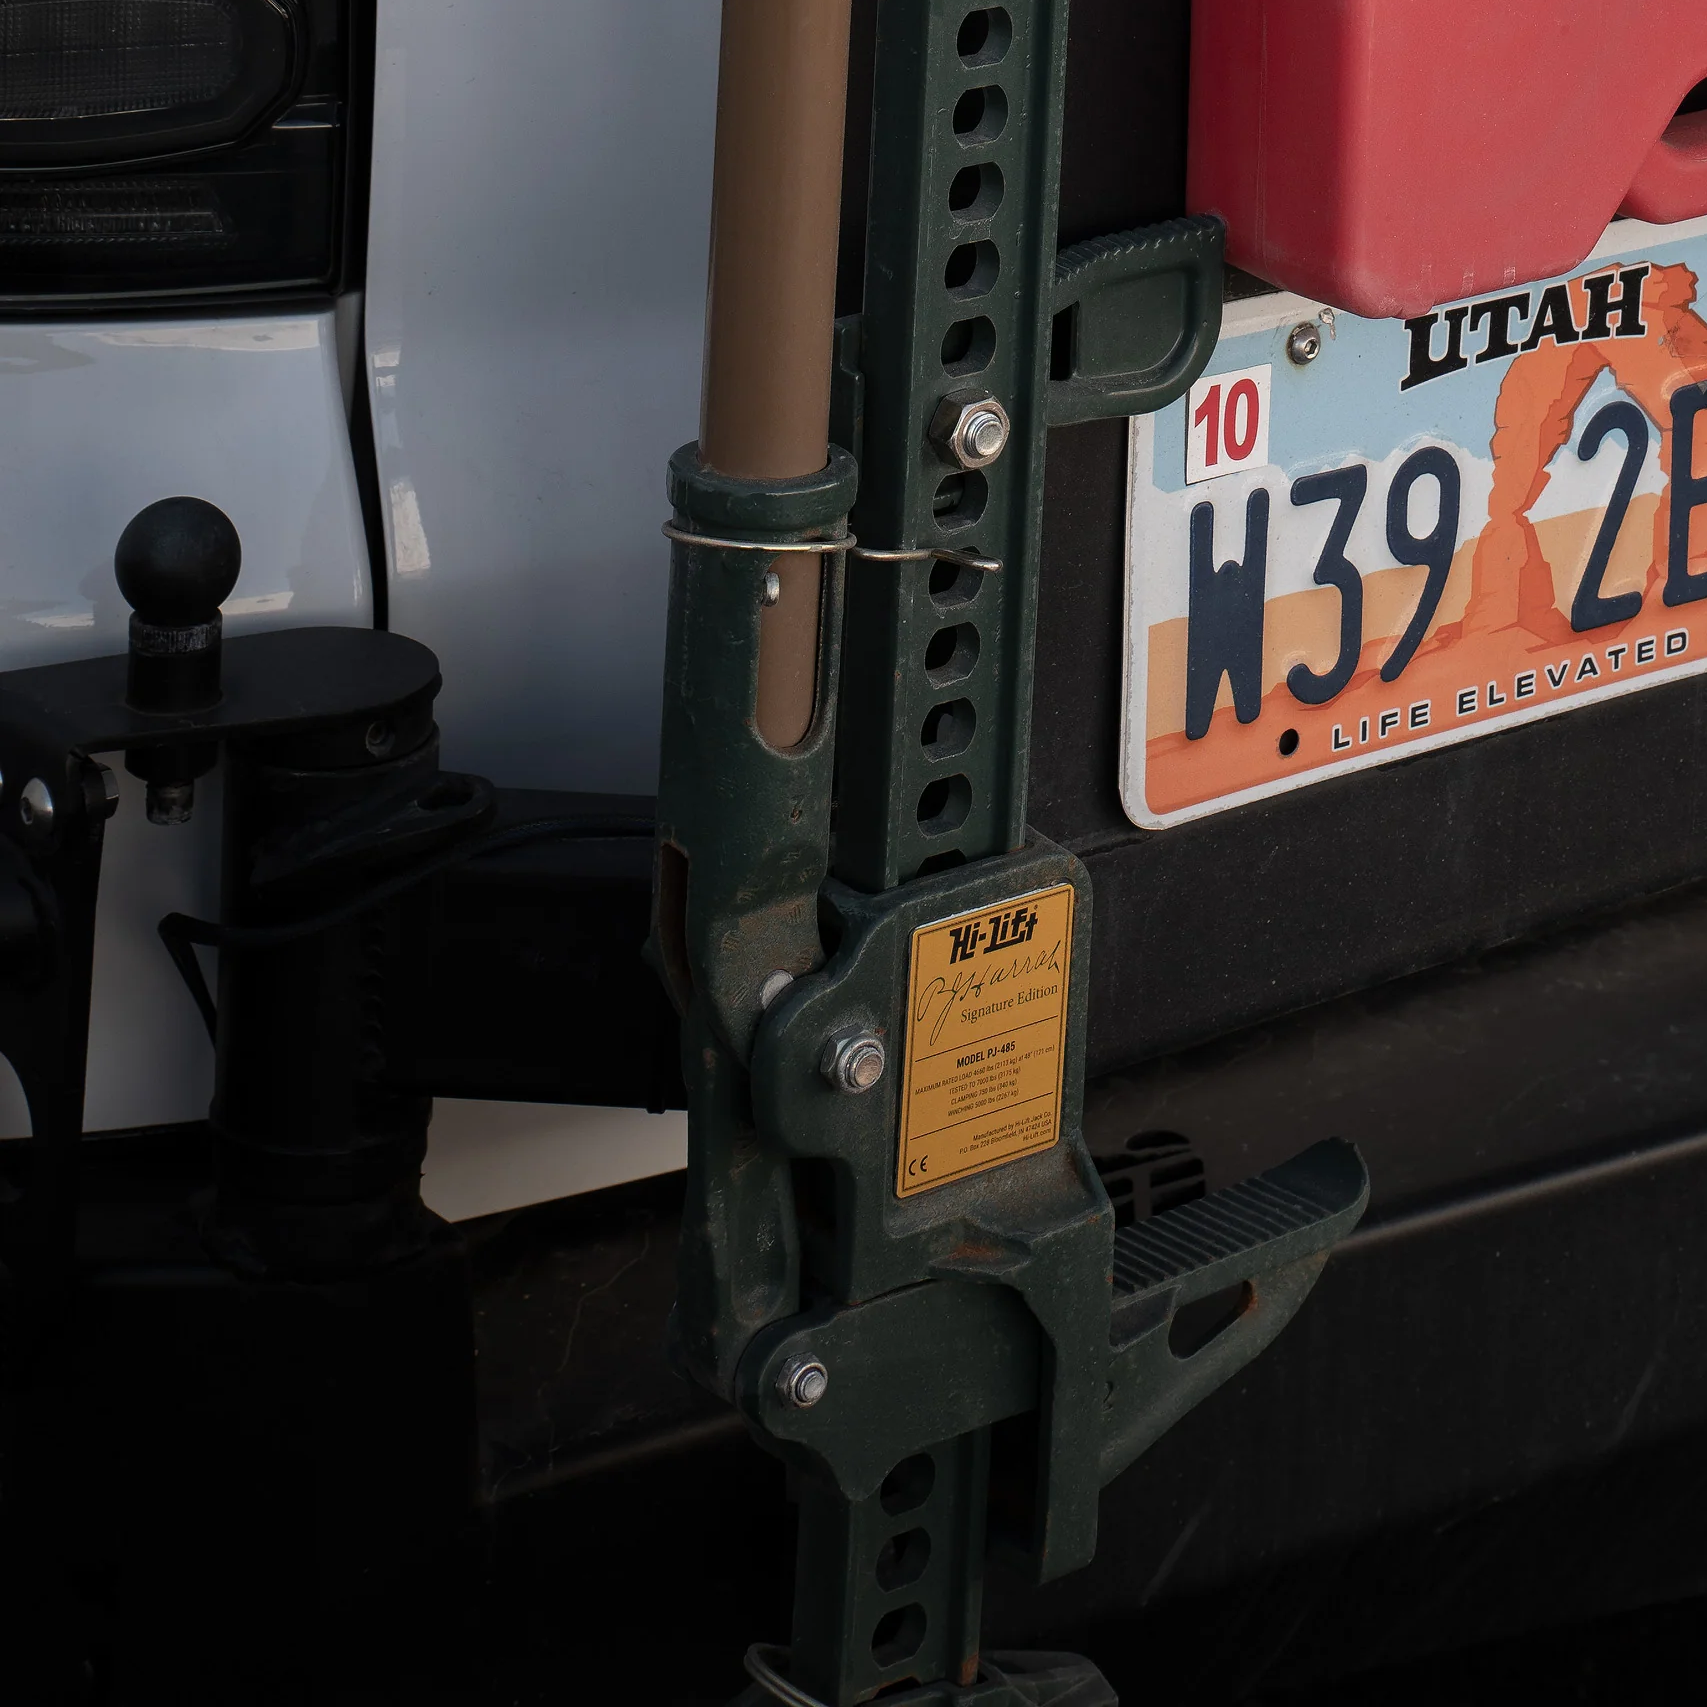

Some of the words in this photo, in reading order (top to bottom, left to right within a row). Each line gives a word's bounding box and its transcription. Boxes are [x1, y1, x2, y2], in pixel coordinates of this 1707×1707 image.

[1401, 265, 1649, 390] UTAH
[1193, 377, 1260, 467] 10
[1185, 445, 1461, 741] W39
[1331, 701, 1433, 752] LIFE
[1456, 629, 1690, 717] ELEVATED
[960, 997, 1014, 1024] Signature
[1017, 984, 1058, 1005] Edition
[956, 1051, 985, 1068] MODEL
[987, 1041, 1016, 1059] PJ-485
[915, 1081, 941, 1095] MAXIMUM
[941, 1076, 959, 1087] RATED
[959, 1071, 973, 1082] LOAD
[949, 1083, 968, 1095] TESTED
[947, 1104, 974, 1116] WINCHING
[950, 1092, 978, 1105] CLAMPING
[972, 1126, 1008, 1141] Manufactured
[1030, 1113, 1043, 1123] Jack
[1041, 1119, 1052, 1127] USA
